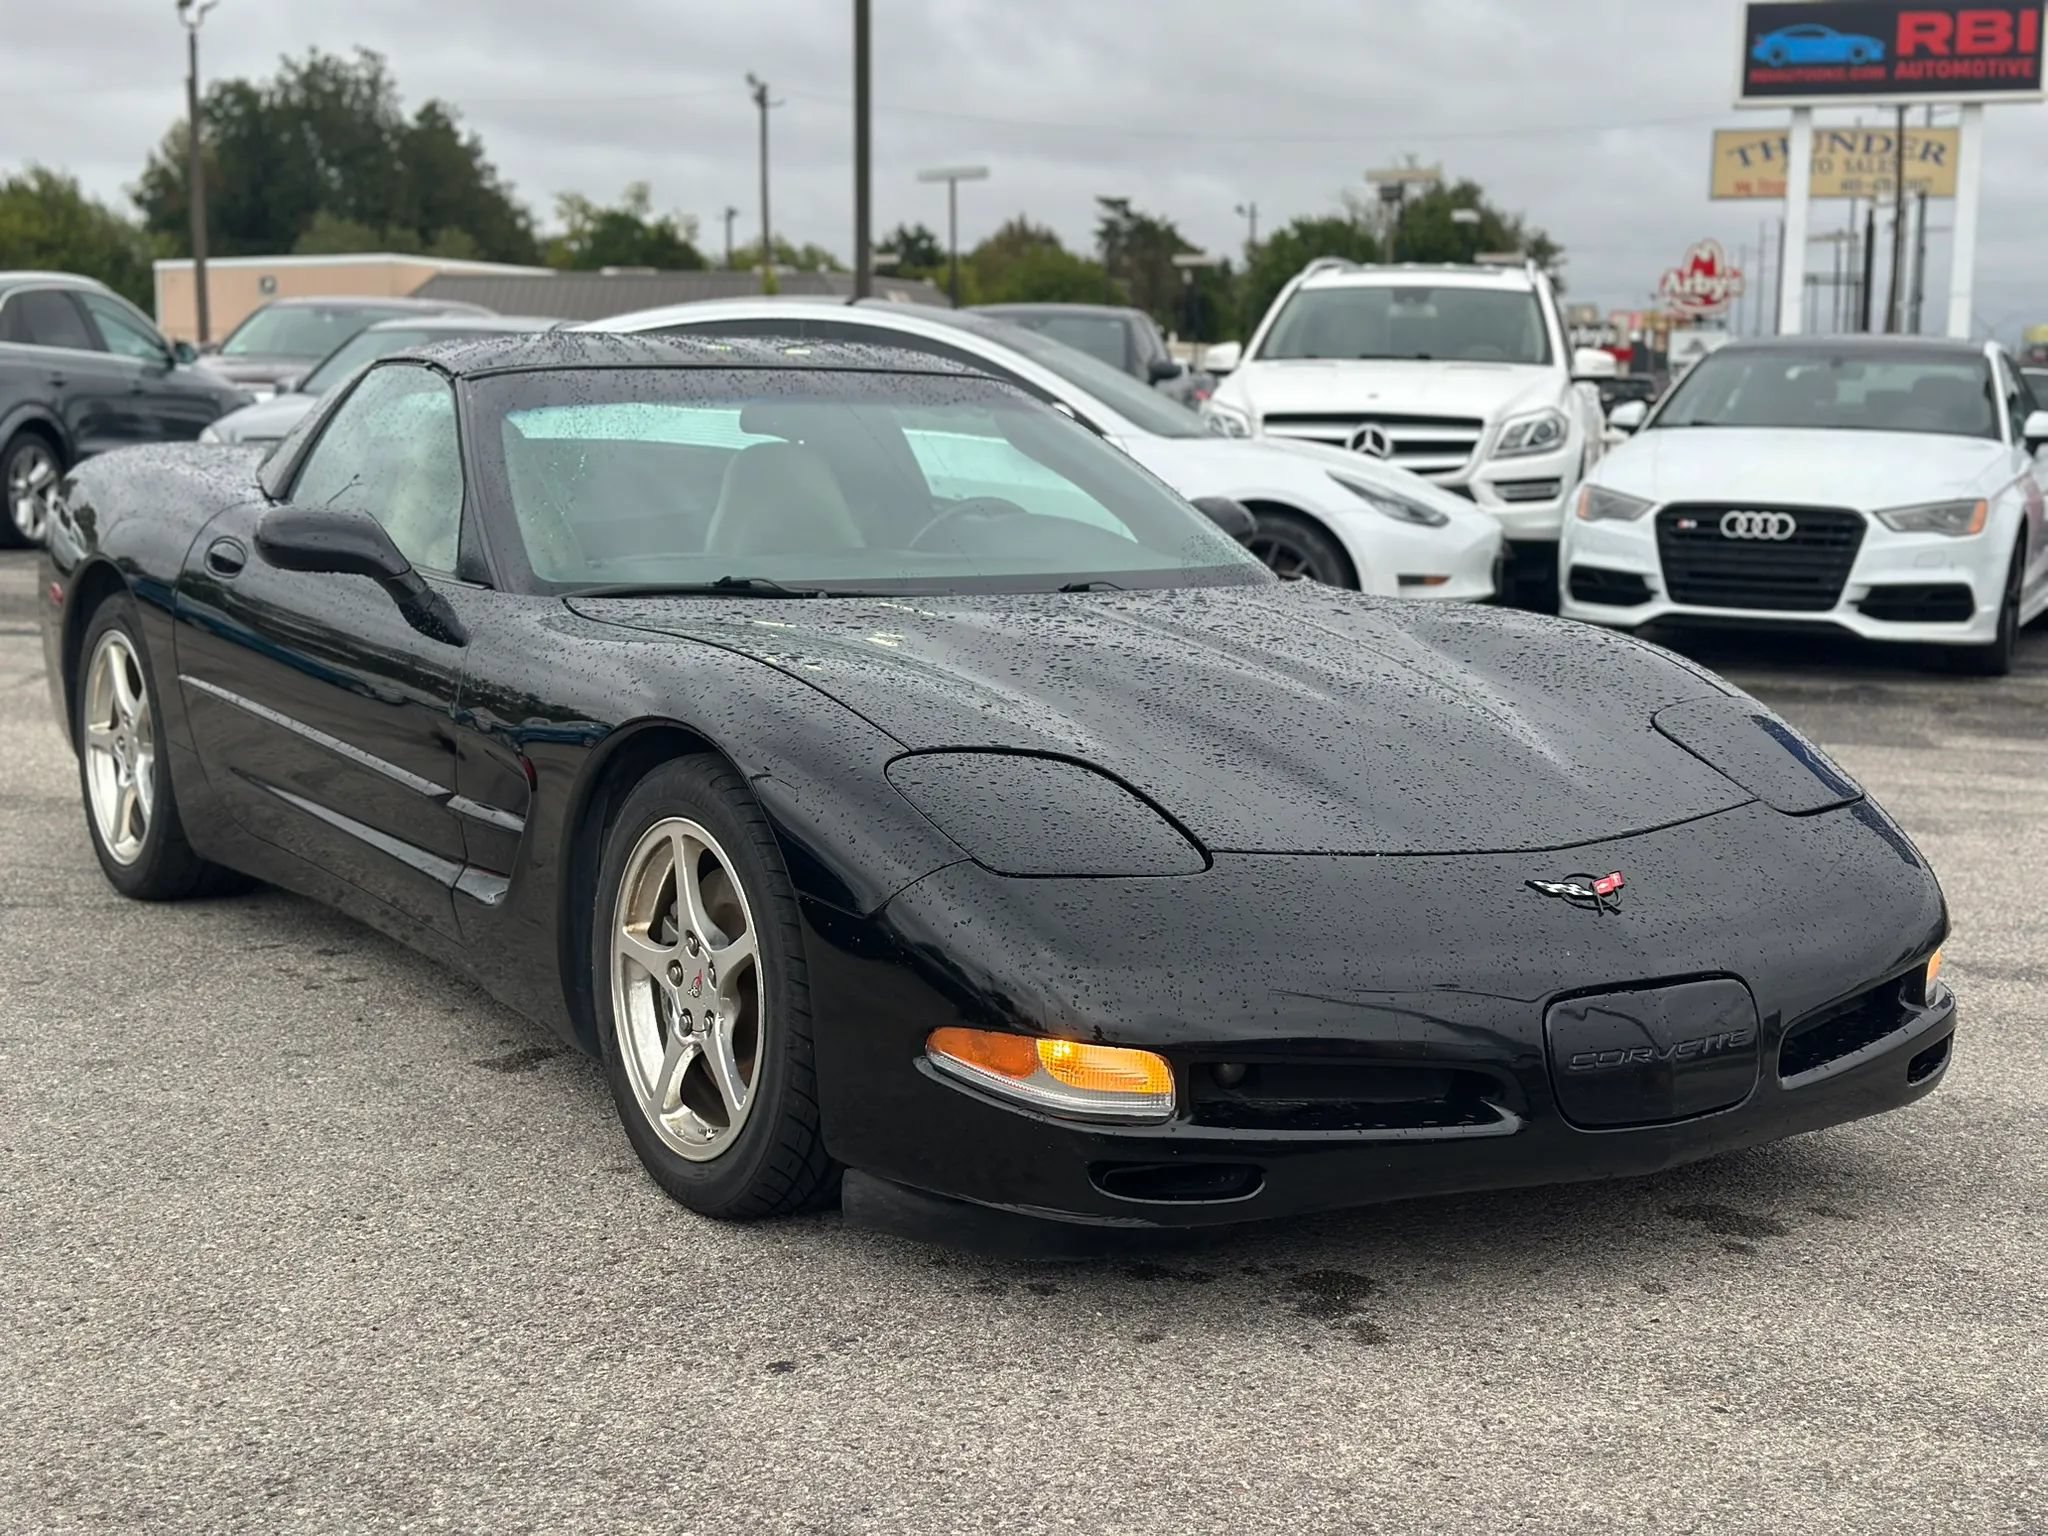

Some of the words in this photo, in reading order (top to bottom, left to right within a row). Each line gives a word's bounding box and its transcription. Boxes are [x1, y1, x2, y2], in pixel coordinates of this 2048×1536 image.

[1895, 9, 2039, 57] RBI
[1895, 57, 2034, 80] AUTOMOTIVE
[1661, 268, 1744, 301] Arby's
[1568, 1029, 1750, 1071] CORVETTE
